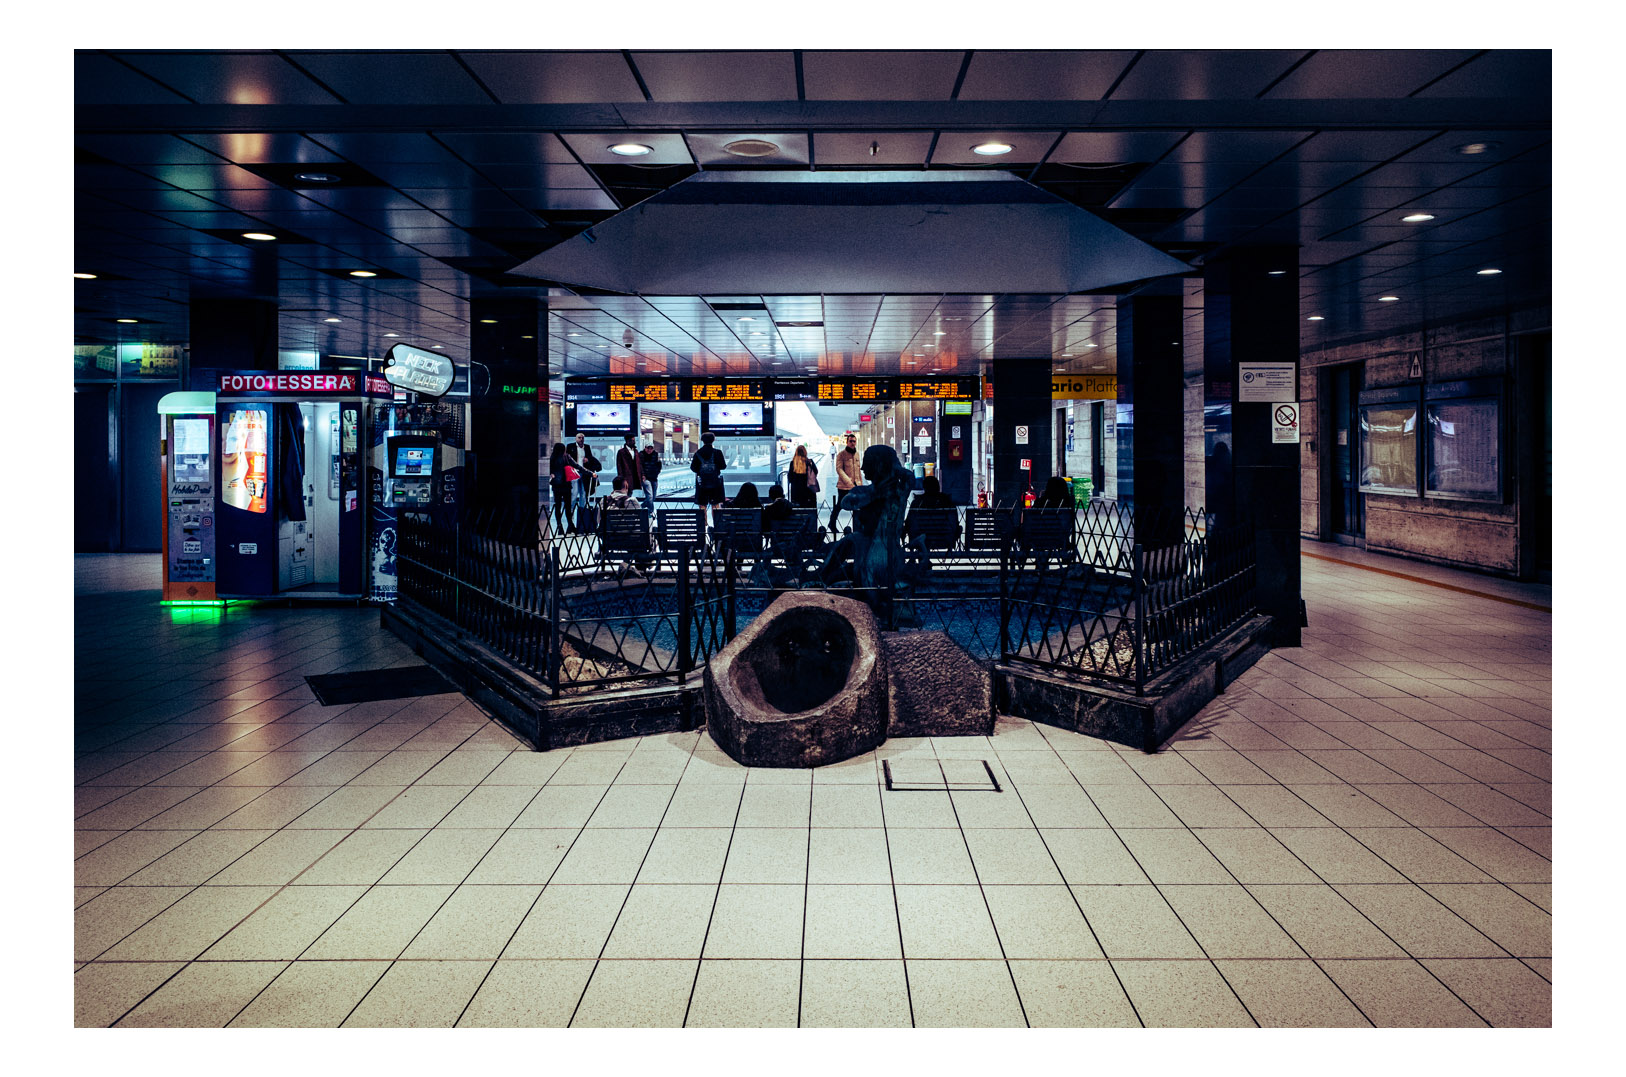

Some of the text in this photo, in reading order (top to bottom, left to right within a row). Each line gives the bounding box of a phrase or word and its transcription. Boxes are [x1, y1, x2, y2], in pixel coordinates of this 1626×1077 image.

[405, 353, 443, 375] NECK
[221, 375, 352, 390] FOTOTESSERA
[764, 401, 773, 409] 24
[727, 446, 752, 470] 24
